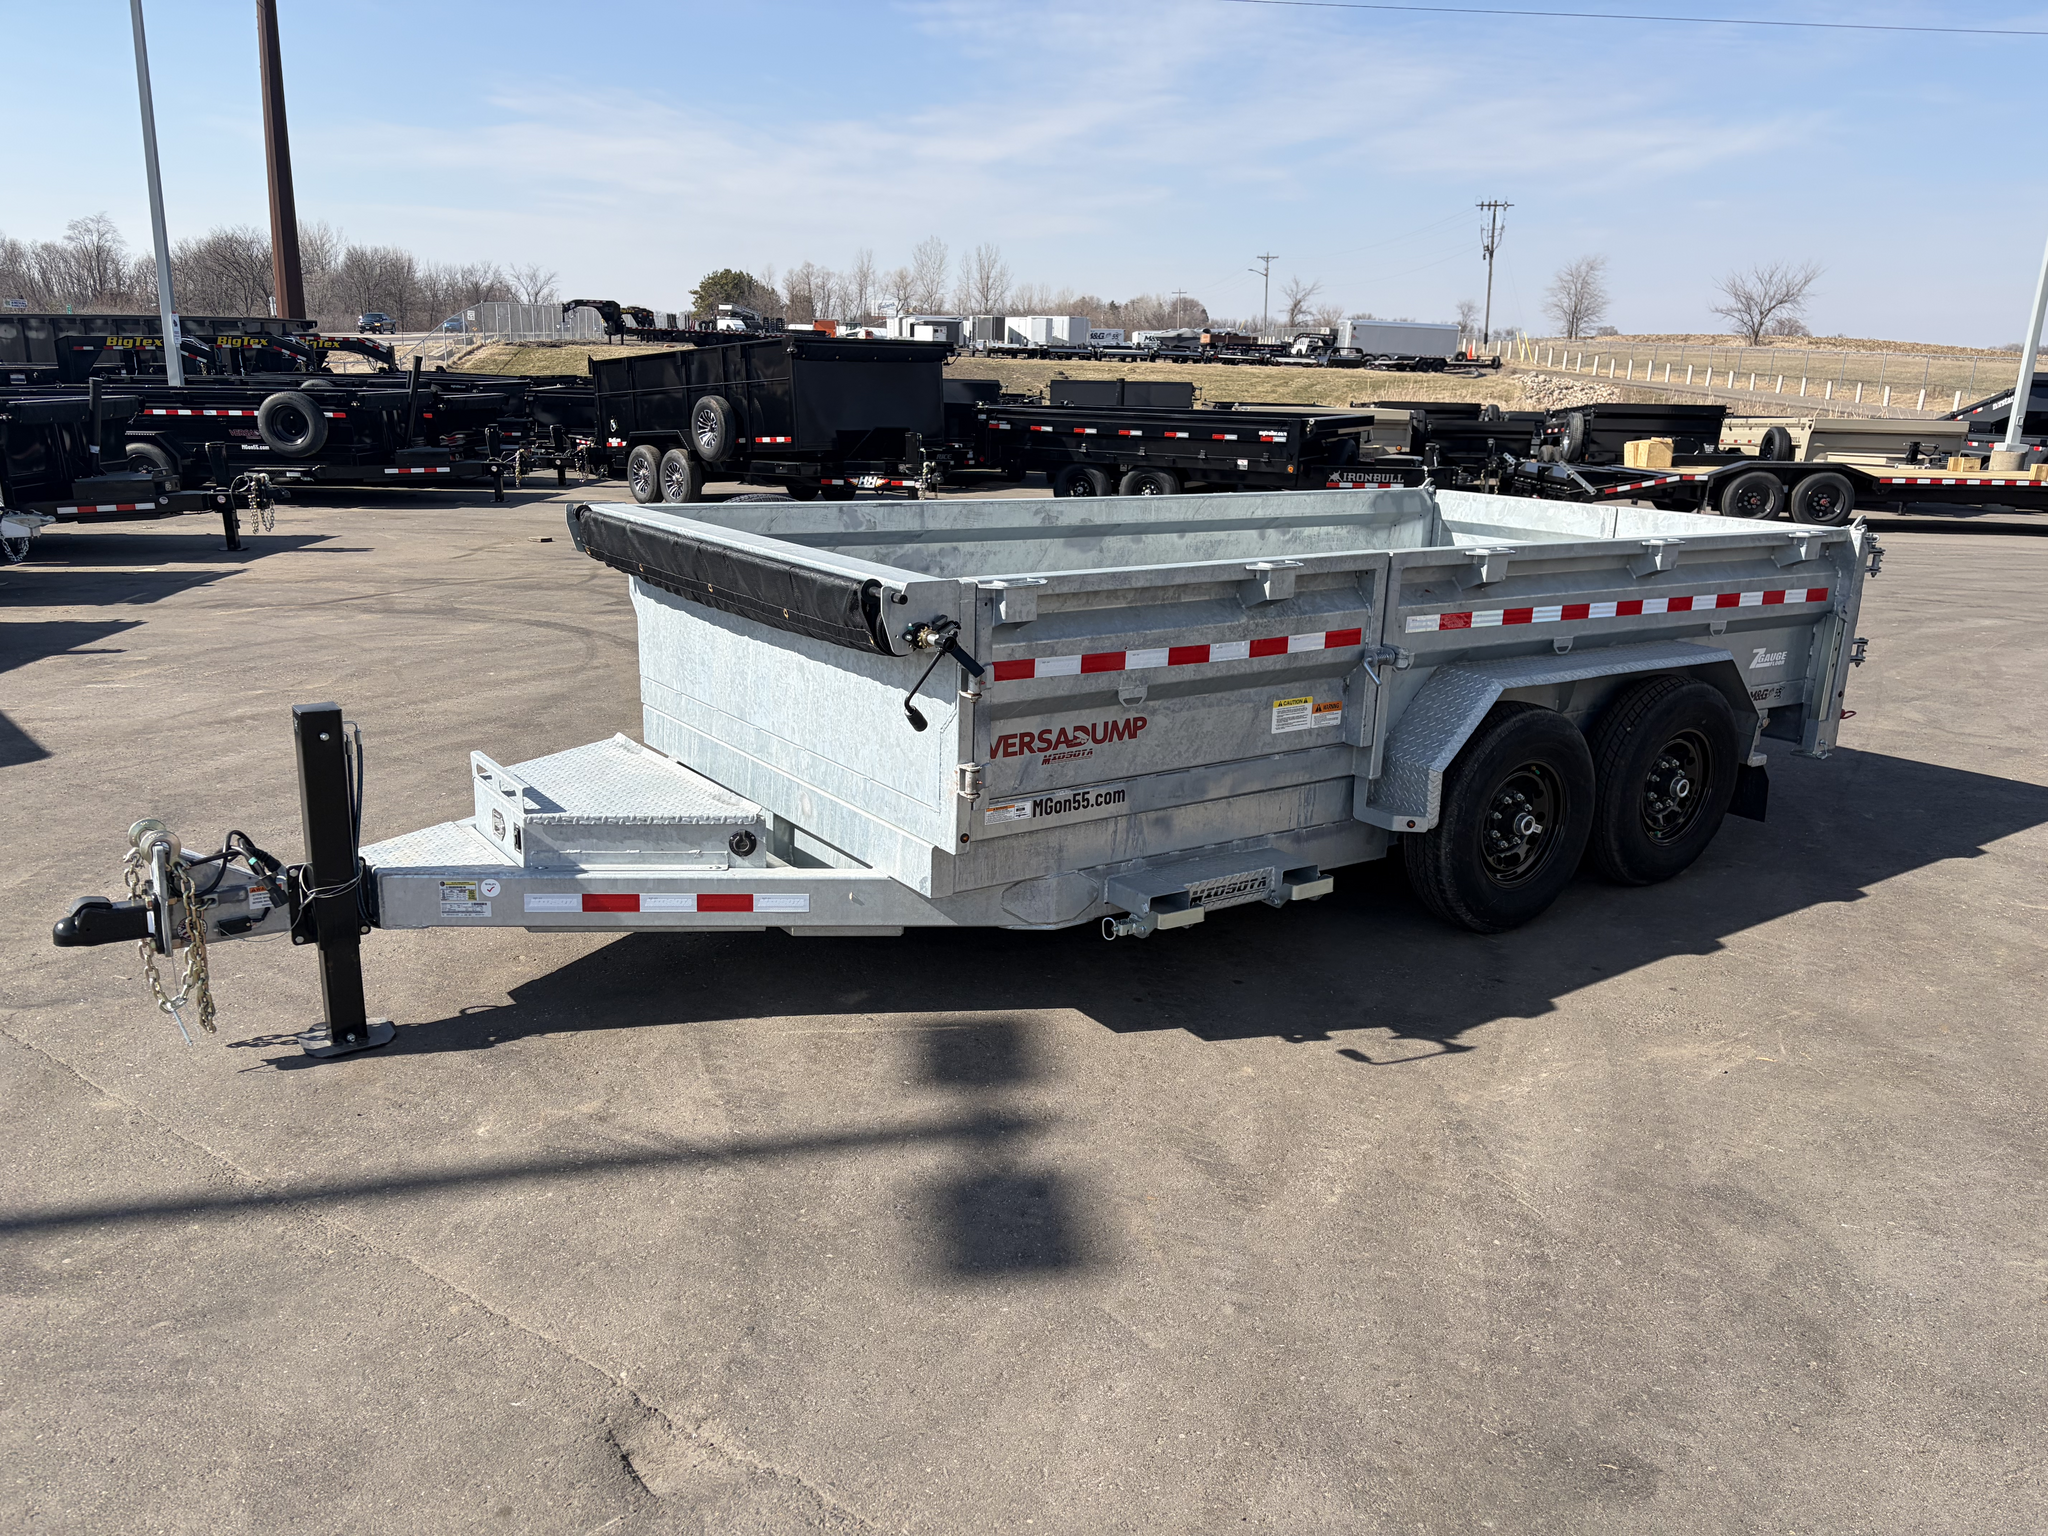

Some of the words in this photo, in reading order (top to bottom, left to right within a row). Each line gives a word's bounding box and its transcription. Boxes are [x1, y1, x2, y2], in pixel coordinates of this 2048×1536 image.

[106, 336, 164, 349] BigTex
[217, 336, 268, 347] BigTex
[1343, 472, 1404, 482] IRONBULL
[1758, 651, 1787, 662] GAUGE
[990, 716, 1148, 760] VERSADUMP
[1033, 789, 1126, 818] MGon55.com
